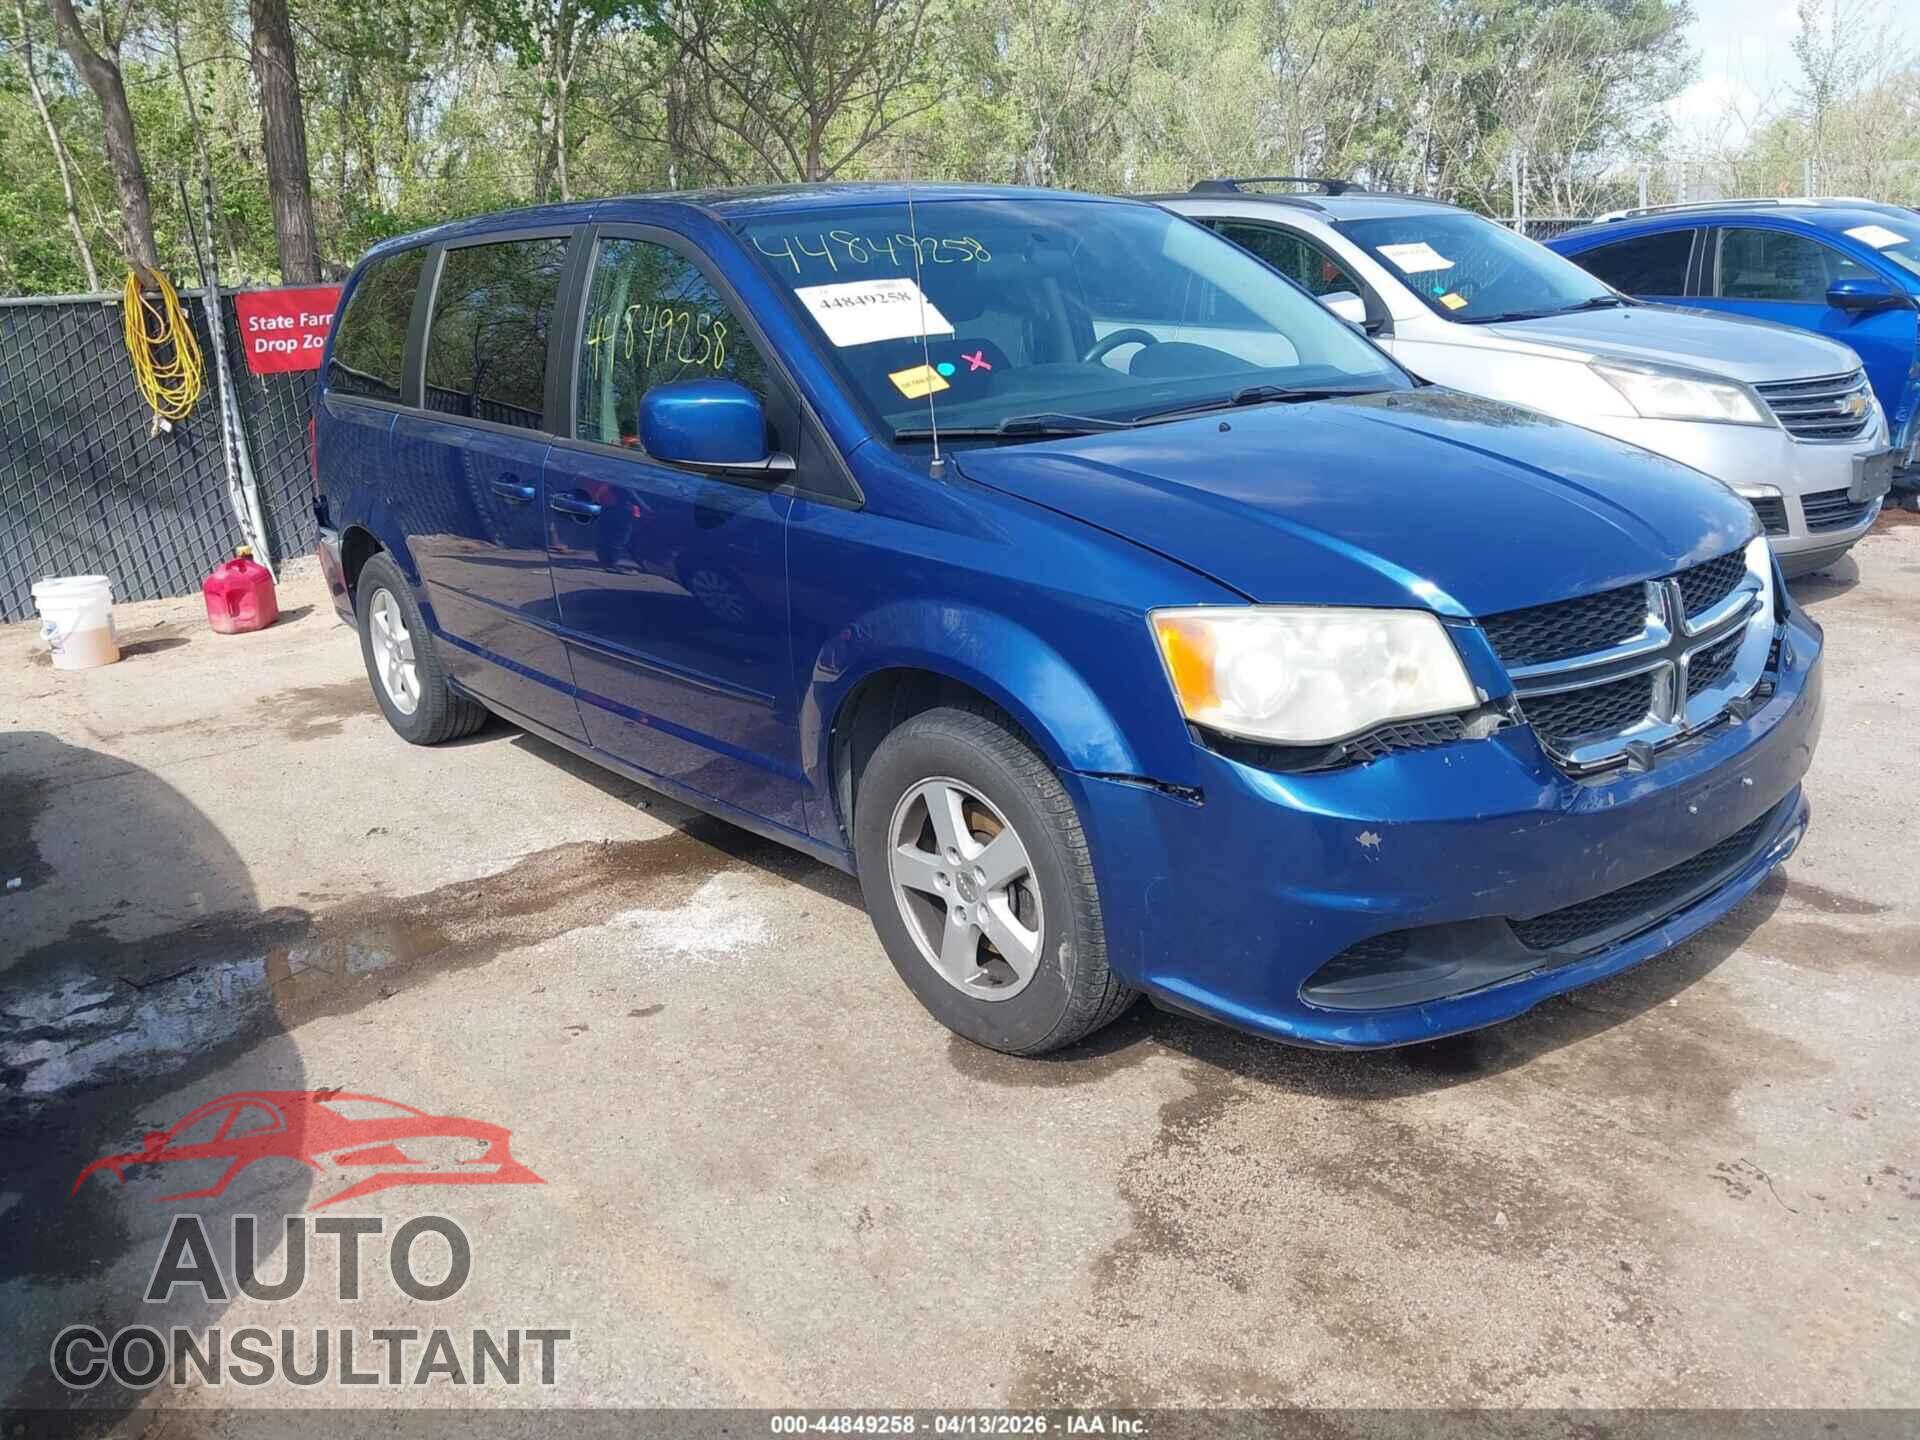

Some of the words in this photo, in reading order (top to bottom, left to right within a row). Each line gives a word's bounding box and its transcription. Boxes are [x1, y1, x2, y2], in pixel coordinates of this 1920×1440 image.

[753, 230, 992, 274] 44849258
[819, 291, 911, 309] 44849258
[249, 314, 294, 331] State
[255, 338, 298, 354] Drop
[303, 334, 326, 349] Zo
[587, 304, 727, 379] 44849258
